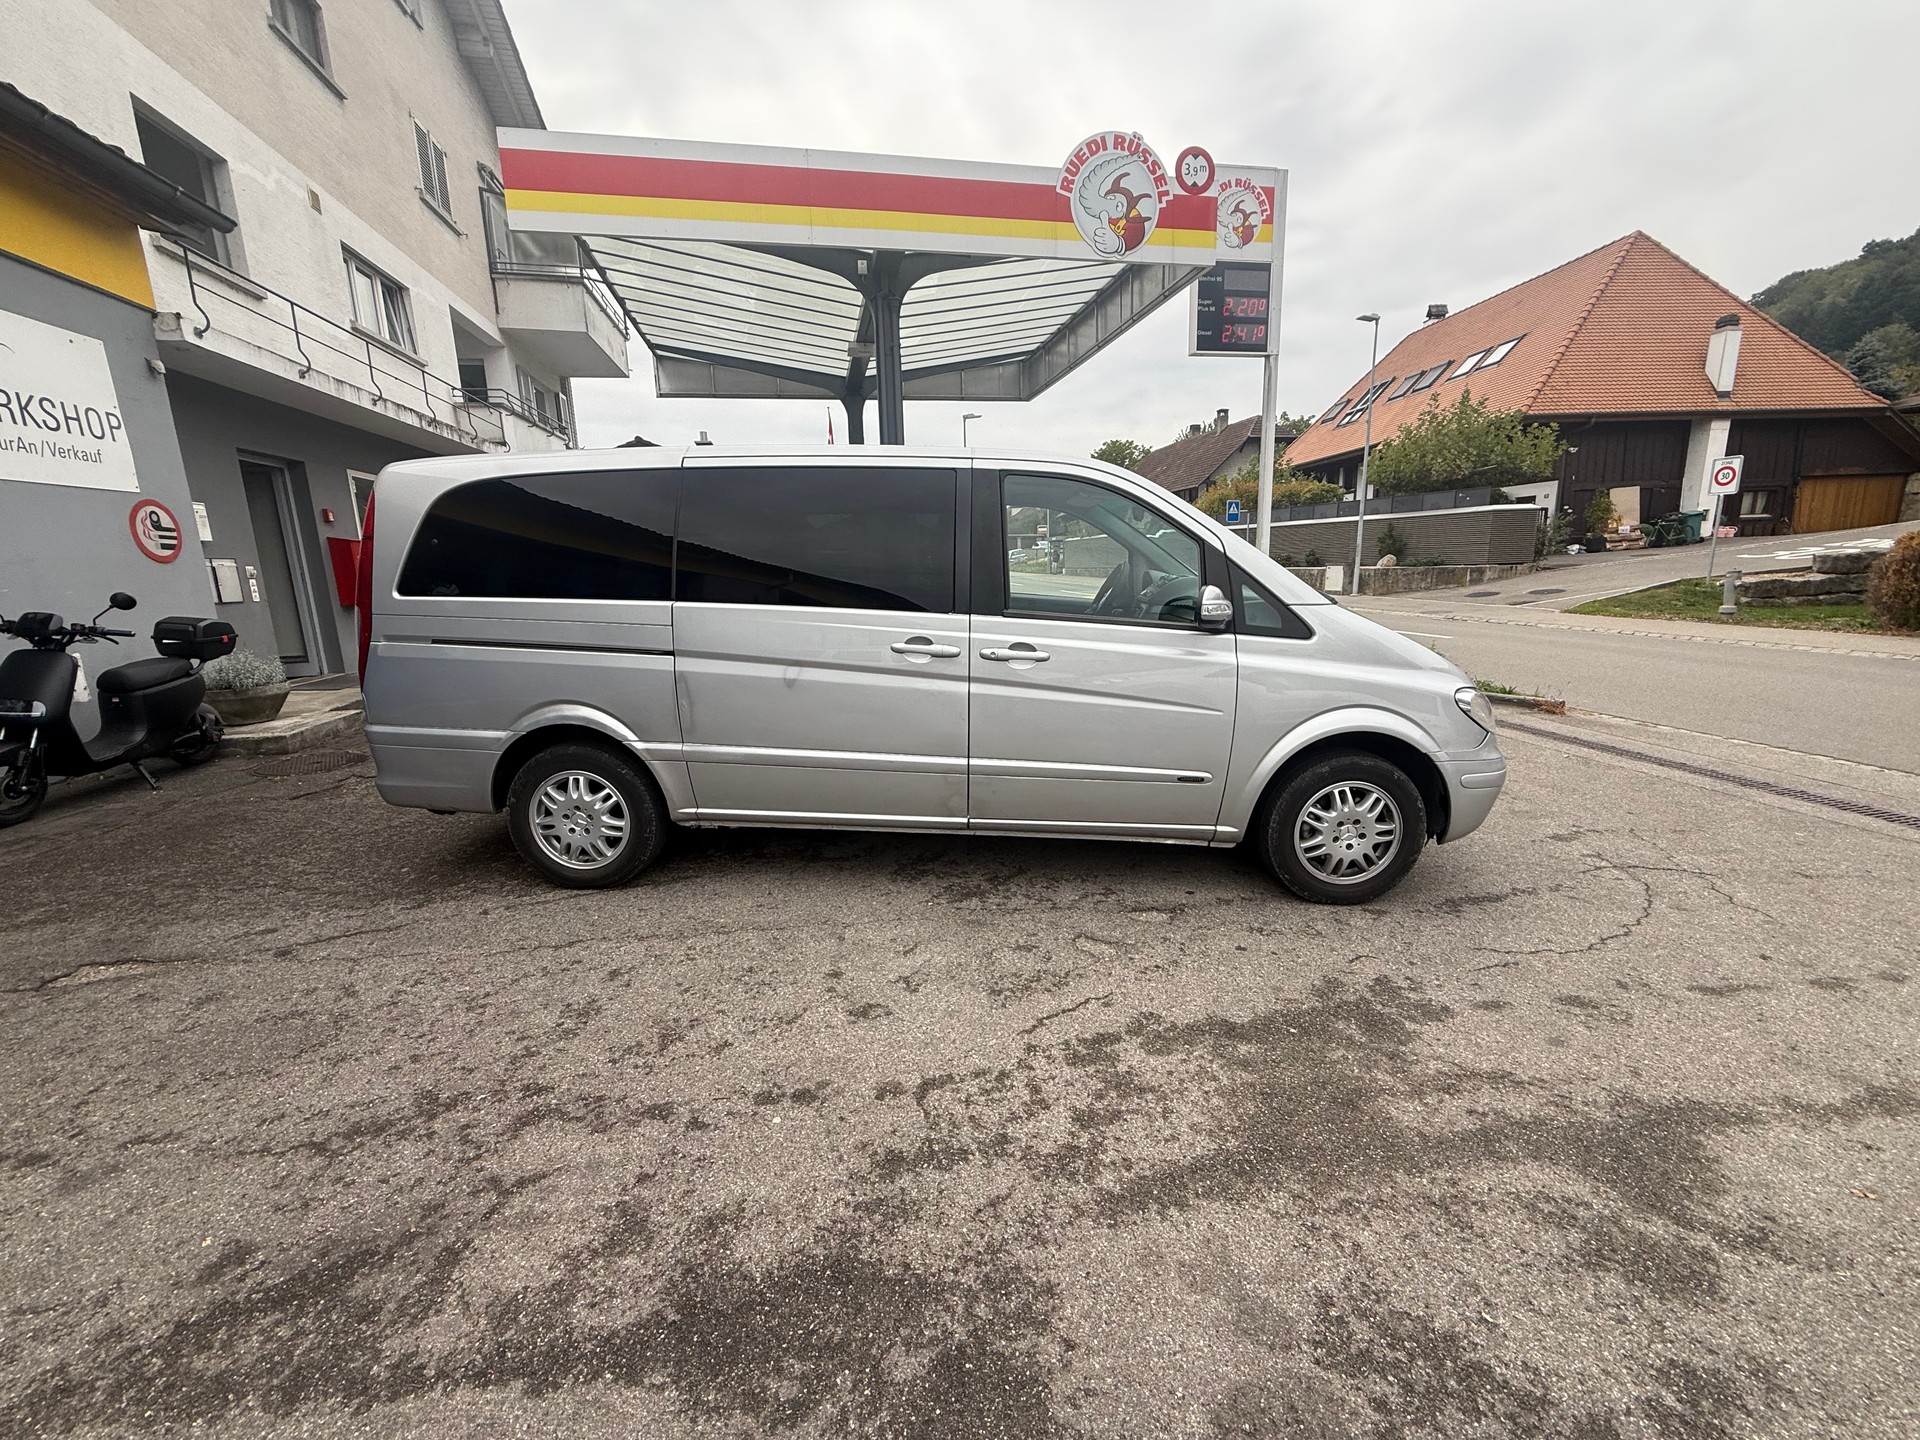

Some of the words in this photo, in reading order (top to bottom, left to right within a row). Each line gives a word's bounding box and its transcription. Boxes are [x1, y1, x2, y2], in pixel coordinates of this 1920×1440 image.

[1060, 135, 1108, 194] RUEDI
[1113, 134, 1170, 204] RÜSSEL
[1235, 177, 1270, 217] RÜSSEL
[1720, 472, 1731, 480] 30
